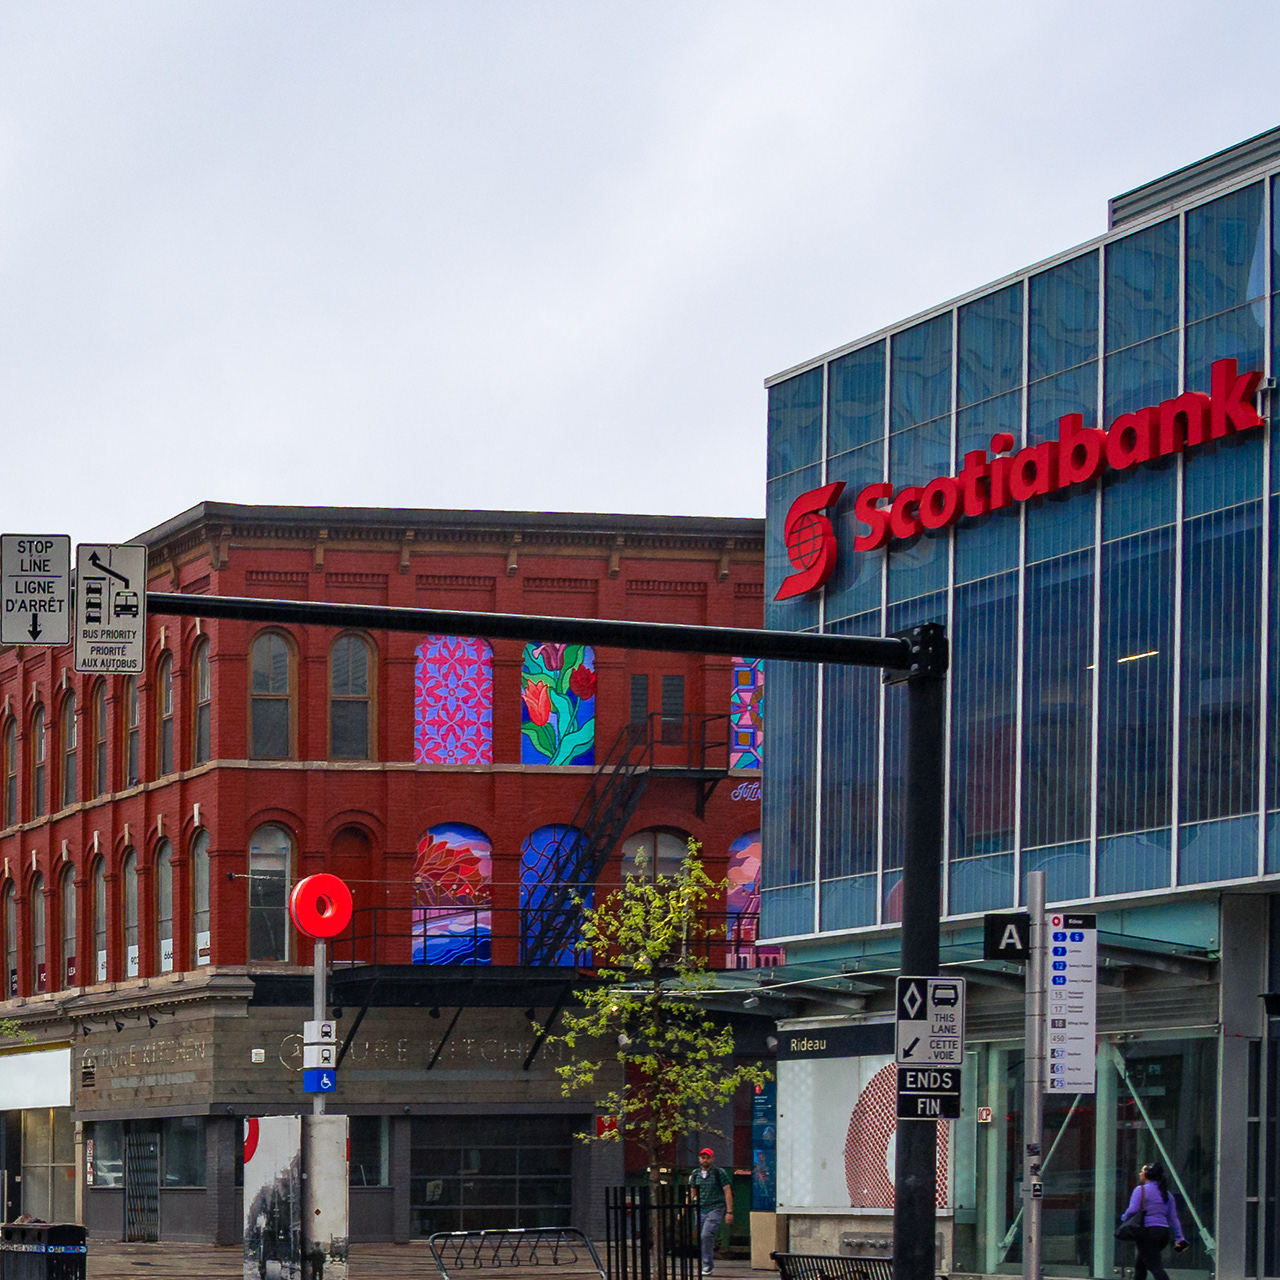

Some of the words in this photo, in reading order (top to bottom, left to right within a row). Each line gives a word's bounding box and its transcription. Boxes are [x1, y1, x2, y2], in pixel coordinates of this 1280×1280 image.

[854, 358, 1265, 552] Scotiabank
[17, 540, 53, 554] STOP
[20, 559, 51, 572] LINE
[15, 580, 55, 594] LIGNE
[5, 597, 65, 613] D'ARRÊT
[82, 630, 99, 639] BUS
[101, 630, 137, 640] PRIORITY
[90, 645, 127, 656] PRIORITÉ
[81, 659, 98, 668] AUX
[100, 659, 137, 668] AUTOBUS
[998, 924, 1023, 949] A
[1055, 977, 1063, 985] 14
[1054, 991, 1063, 999] 15
[934, 1013, 955, 1023] THIS
[931, 1025, 957, 1034] LANE
[790, 1037, 827, 1052] Rideau
[929, 1040, 958, 1049] CETTE
[933, 1051, 954, 1060] VOIE
[906, 1072, 952, 1088] ENDS
[917, 1098, 940, 1115] FIN
